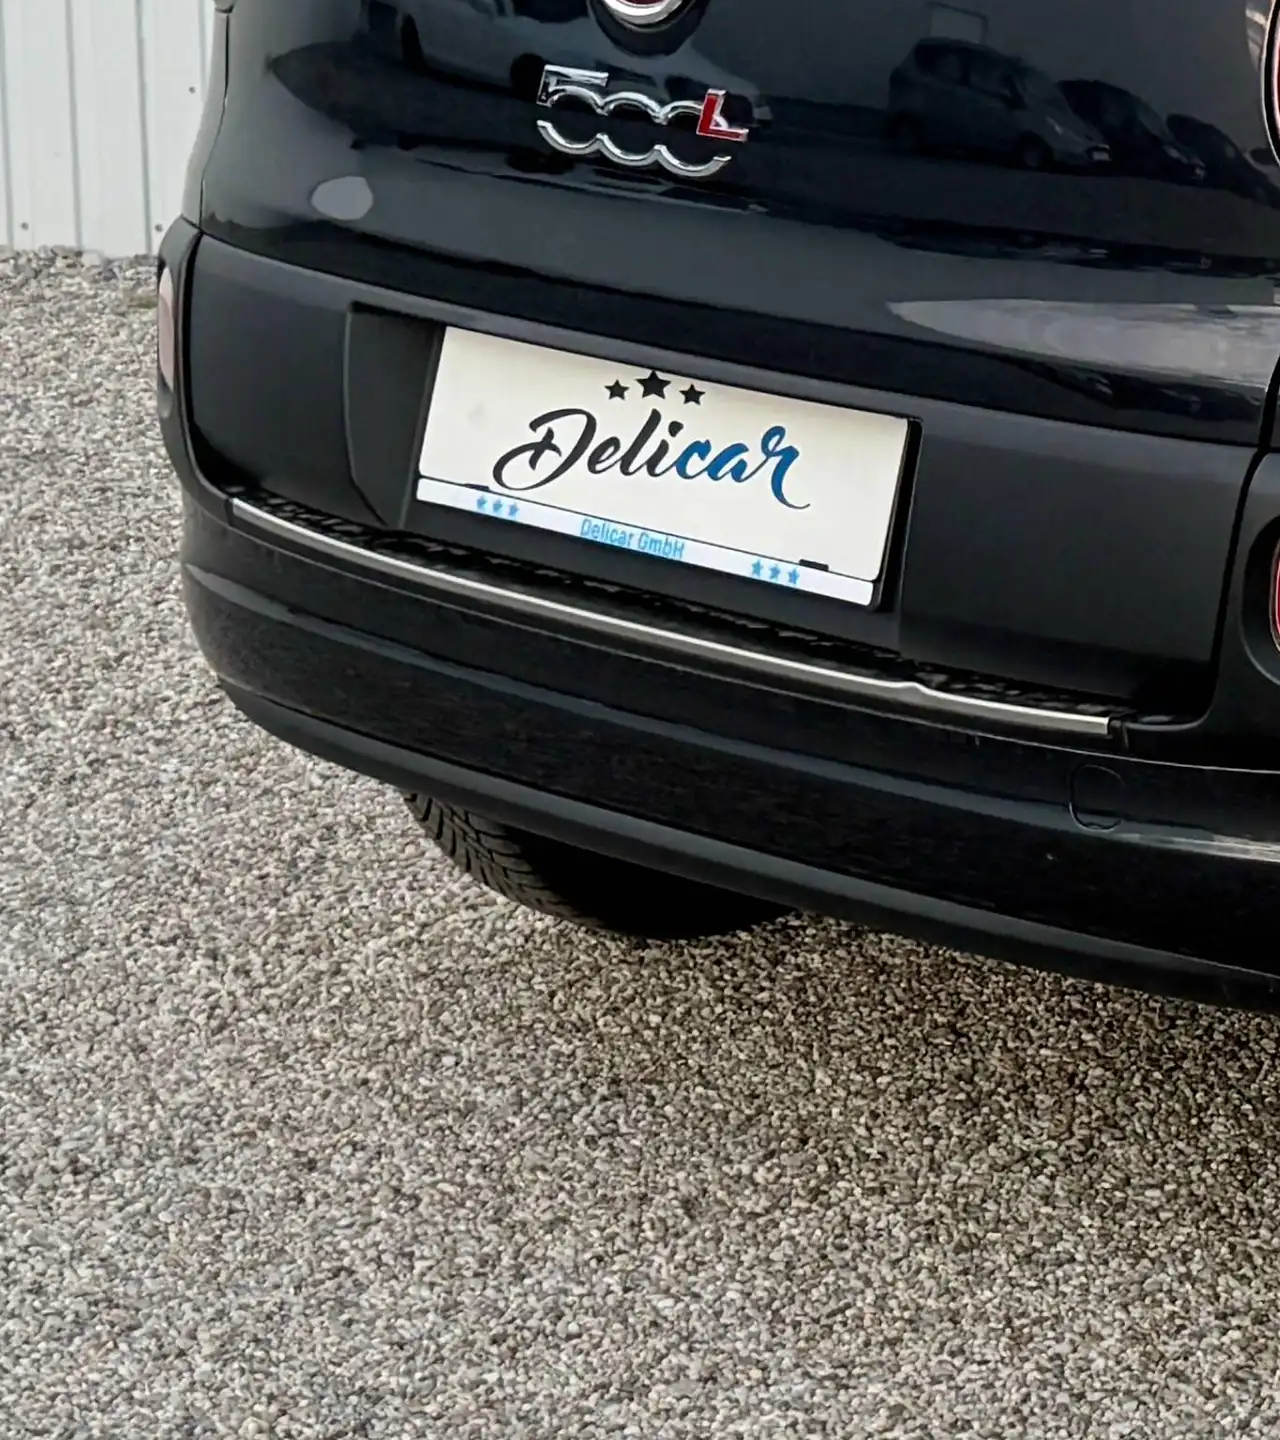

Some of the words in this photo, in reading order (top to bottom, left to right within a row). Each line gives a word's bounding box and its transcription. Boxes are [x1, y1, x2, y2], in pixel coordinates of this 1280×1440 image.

[492, 407, 812, 510] Delicar
[579, 517, 635, 548] Delicar
[636, 532, 686, 561] GmbH
